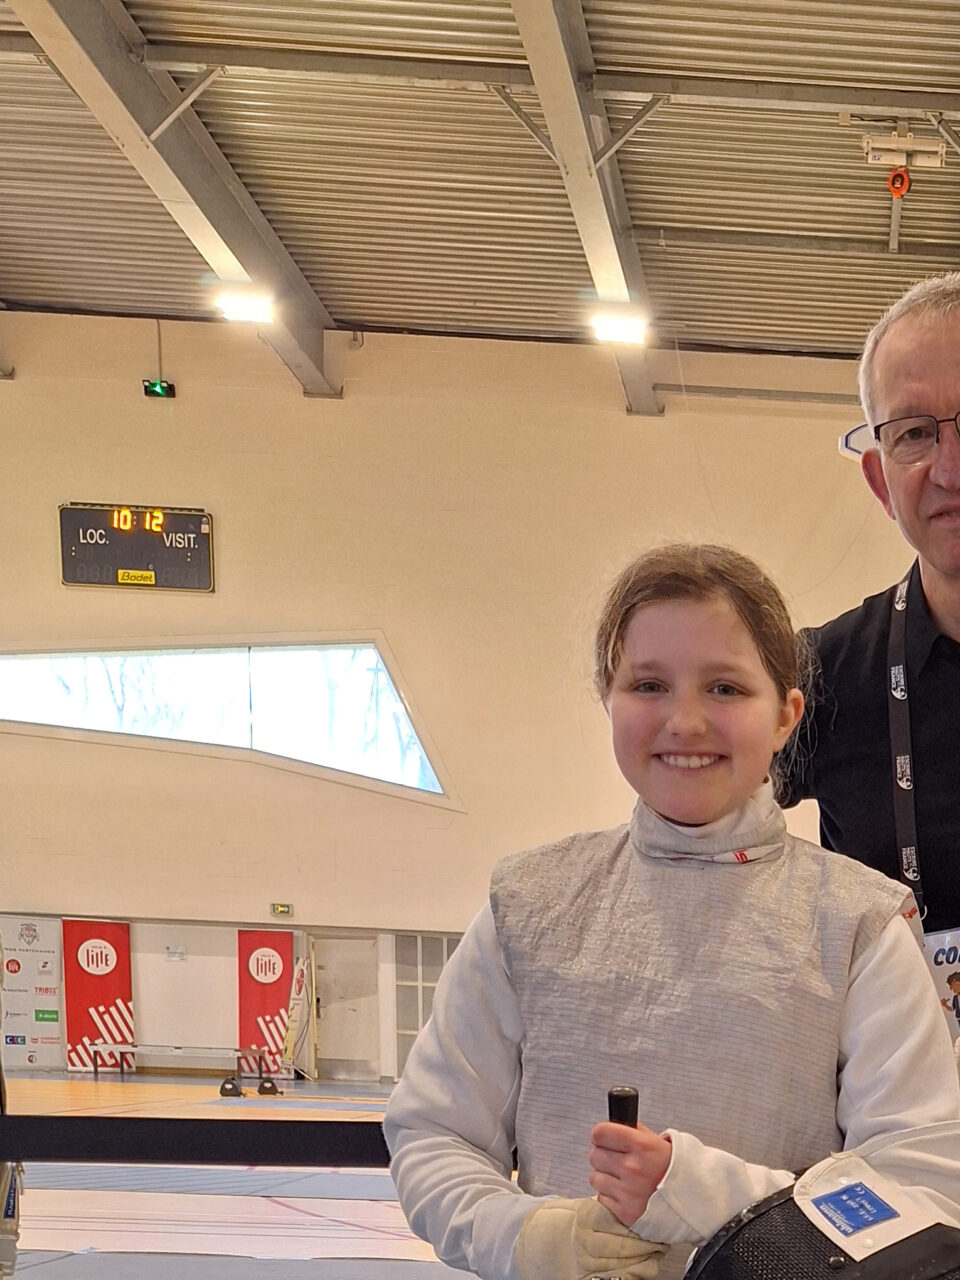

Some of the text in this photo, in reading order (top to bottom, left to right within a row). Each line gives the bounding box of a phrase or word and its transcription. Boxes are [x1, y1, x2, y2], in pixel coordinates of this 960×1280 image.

[79, 528, 109, 545] LOC.
[163, 532, 198, 549] VISIT.
[120, 572, 154, 582] Bodet
[6, 1036, 26, 1045] CIC
